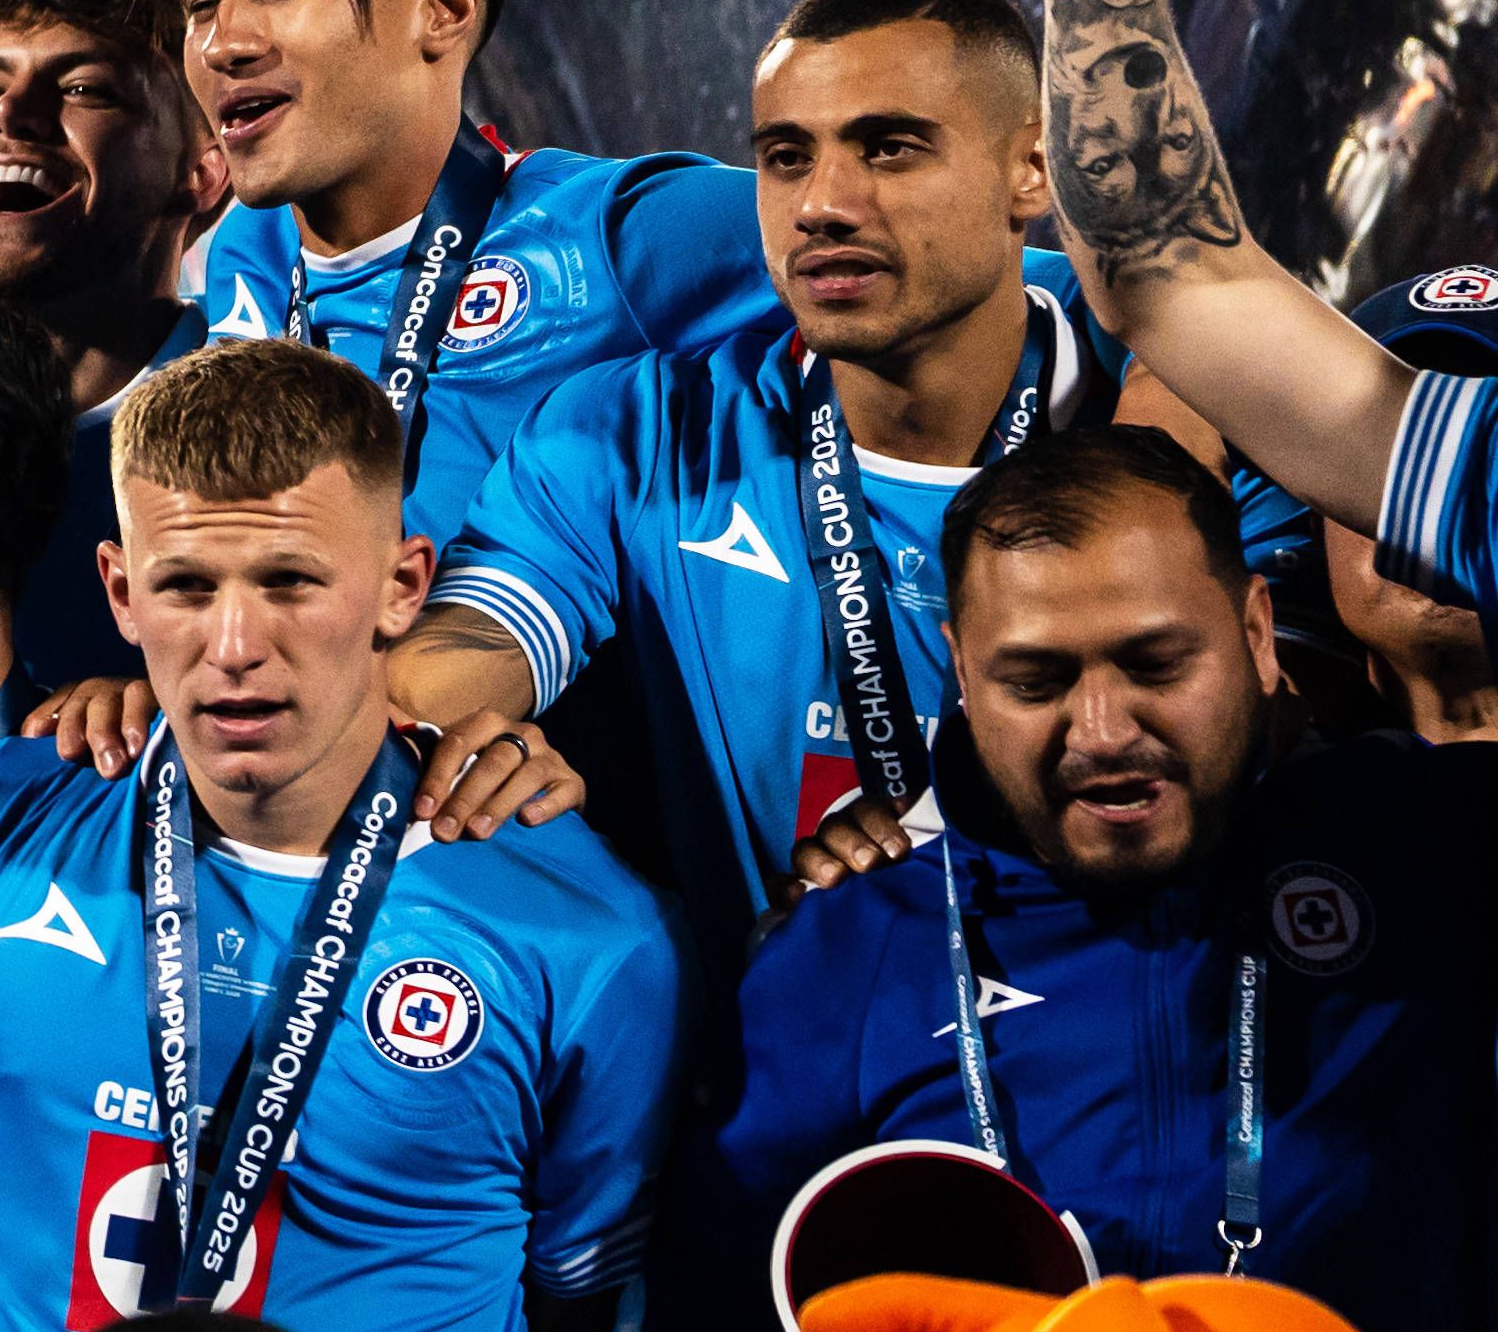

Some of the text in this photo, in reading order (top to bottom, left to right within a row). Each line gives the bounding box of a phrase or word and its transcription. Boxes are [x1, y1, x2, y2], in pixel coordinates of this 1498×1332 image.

[386, 224, 463, 365] Concacaf
[811, 403, 895, 753] CHAMPIONS CUP 2025
[153, 760, 183, 909] Concacaf
[157, 910, 194, 1104] CHAMPIONS
[376, 963, 479, 1015] CLUB DE FUTBOL
[1243, 954, 1257, 989] CUP
[202, 791, 396, 1273] Concacaf CHAMPIONS CUP 2025
[376, 1036, 453, 1068] CRUZ AZUL
[1239, 992, 1256, 1080] CHAMPIONS
[965, 1037, 989, 1126] CHAMPIONS
[169, 1106, 190, 1177] CUP
